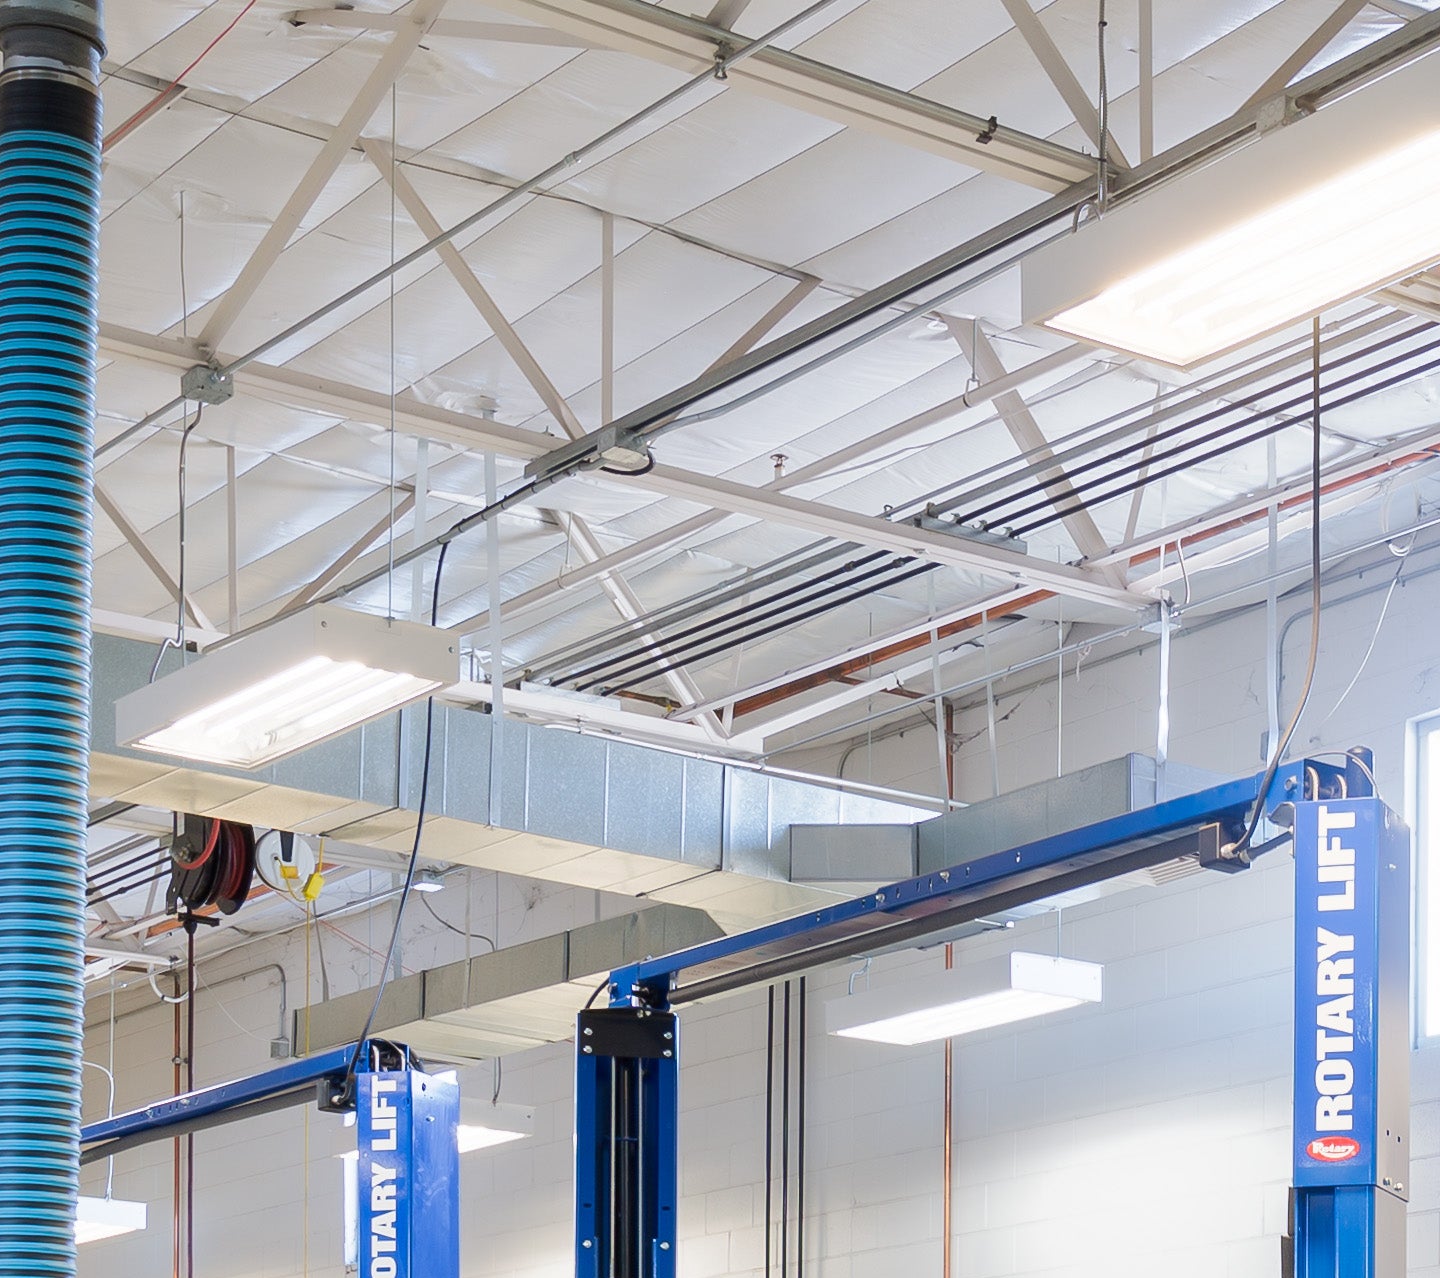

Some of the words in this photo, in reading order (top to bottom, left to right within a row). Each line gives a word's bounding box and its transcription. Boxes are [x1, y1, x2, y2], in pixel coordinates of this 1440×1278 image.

[1317, 805, 1356, 911] LIFT
[1314, 926, 1355, 1132] ROTARY
[371, 1075, 397, 1151] LIFT
[1312, 1140, 1356, 1159] Rotary
